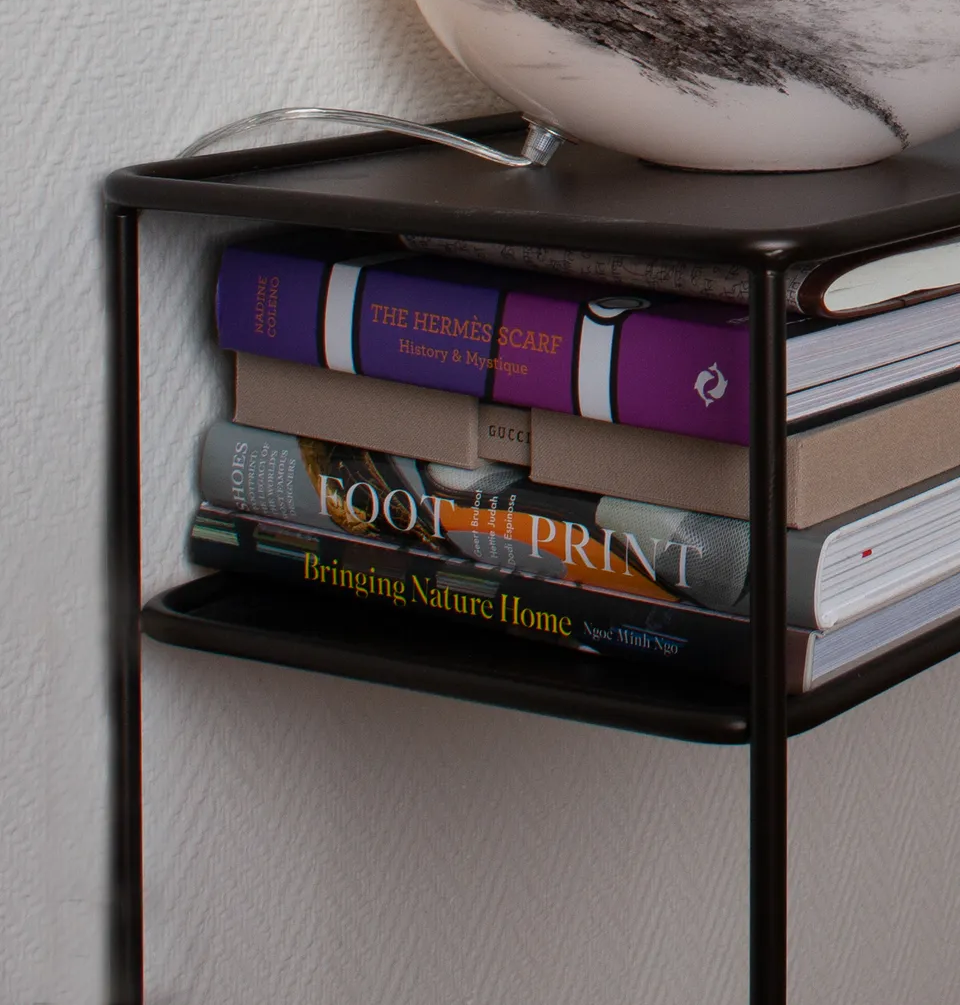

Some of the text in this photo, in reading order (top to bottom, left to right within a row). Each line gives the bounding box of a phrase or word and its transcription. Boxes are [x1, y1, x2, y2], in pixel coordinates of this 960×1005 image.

[254, 276, 267, 333] NADINE
[370, 303, 563, 354] THE HERMÈS SCARF
[399, 339, 528, 375] History & Mystique
[489, 425, 530, 443] GUCCI
[231, 442, 249, 511] SHOES
[318, 474, 703, 588] FOOT PRINT
[470, 488, 483, 557] Geert Bruloot
[488, 496, 499, 528] Judah
[504, 494, 516, 566] Dodi Espinosa
[304, 552, 571, 636] Bringing Nature Home
[583, 621, 678, 656] Ngoc Minh Ngo
